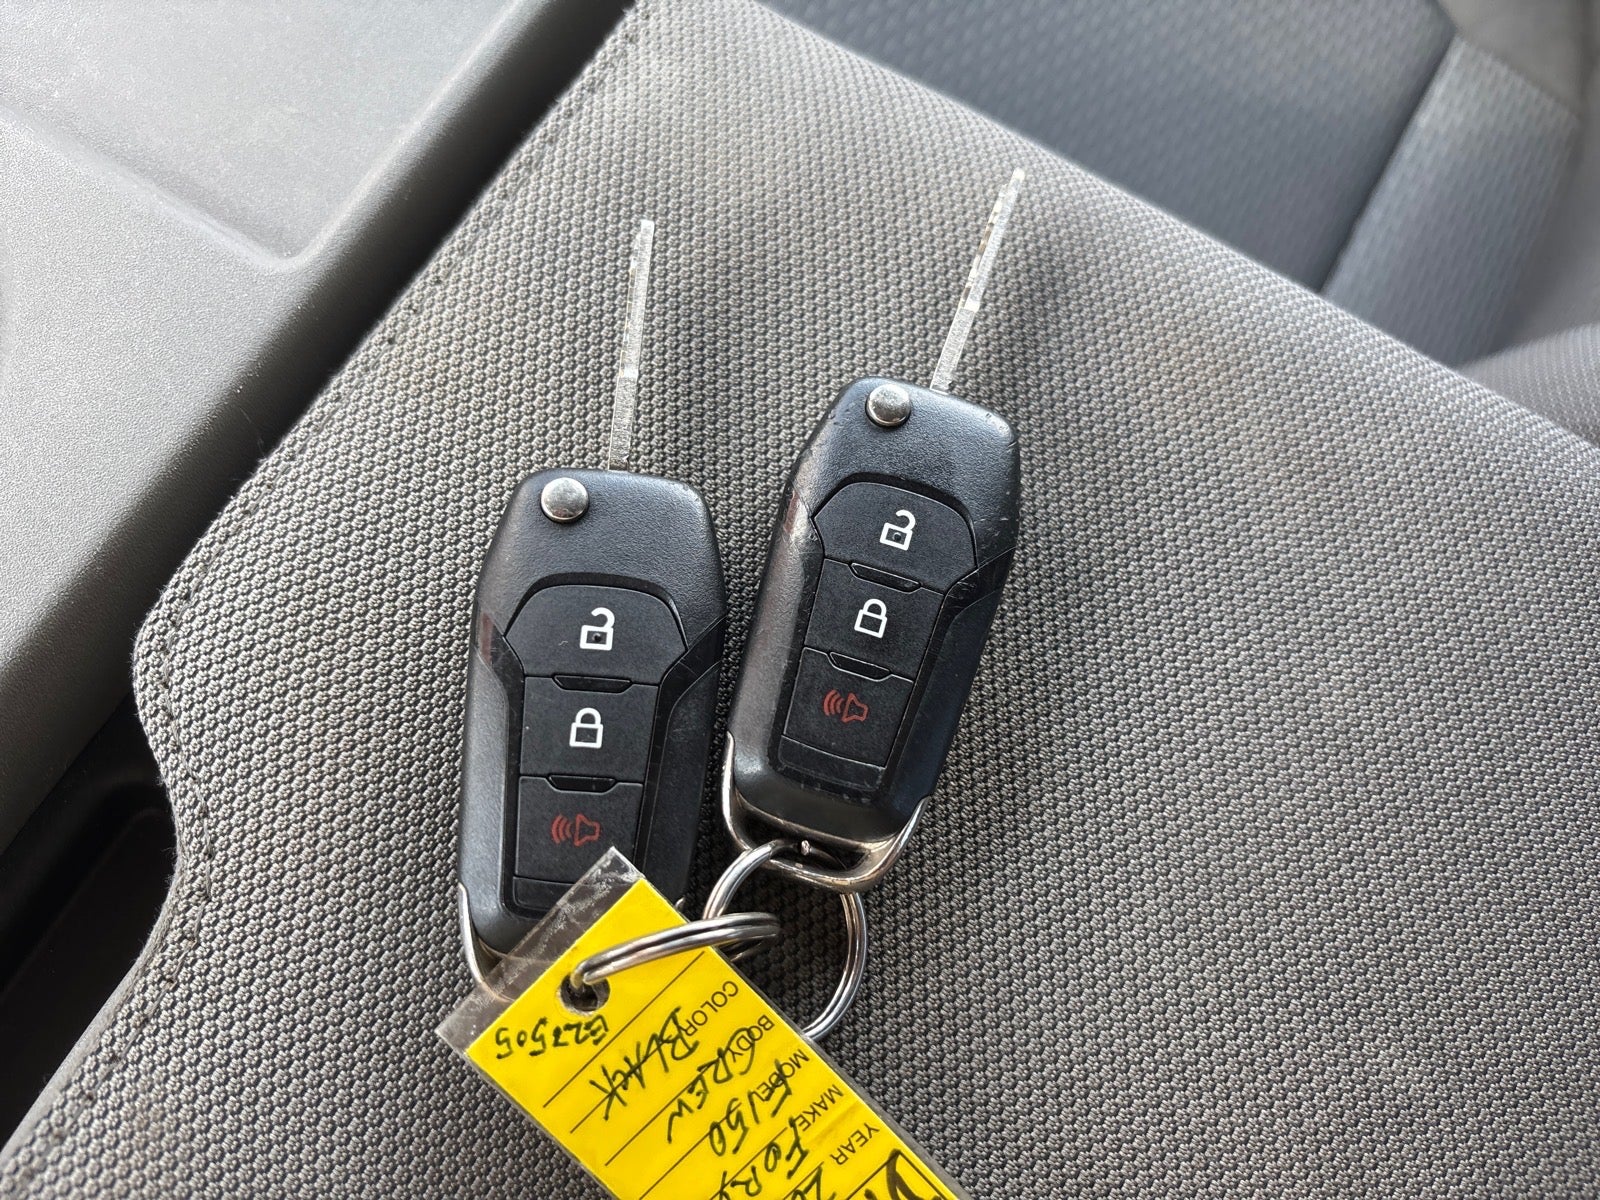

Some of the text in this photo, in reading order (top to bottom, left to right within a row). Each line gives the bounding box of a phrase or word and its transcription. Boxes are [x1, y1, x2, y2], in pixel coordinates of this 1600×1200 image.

[682, 981, 739, 1037] COLOR
[588, 1006, 699, 1121] BLACK
[727, 1014, 776, 1063] BODY
[668, 1027, 756, 1144] CREW
[756, 1048, 811, 1102] MODEL
[797, 1083, 844, 1132] MAKE
[829, 1122, 880, 1166] YEAR
